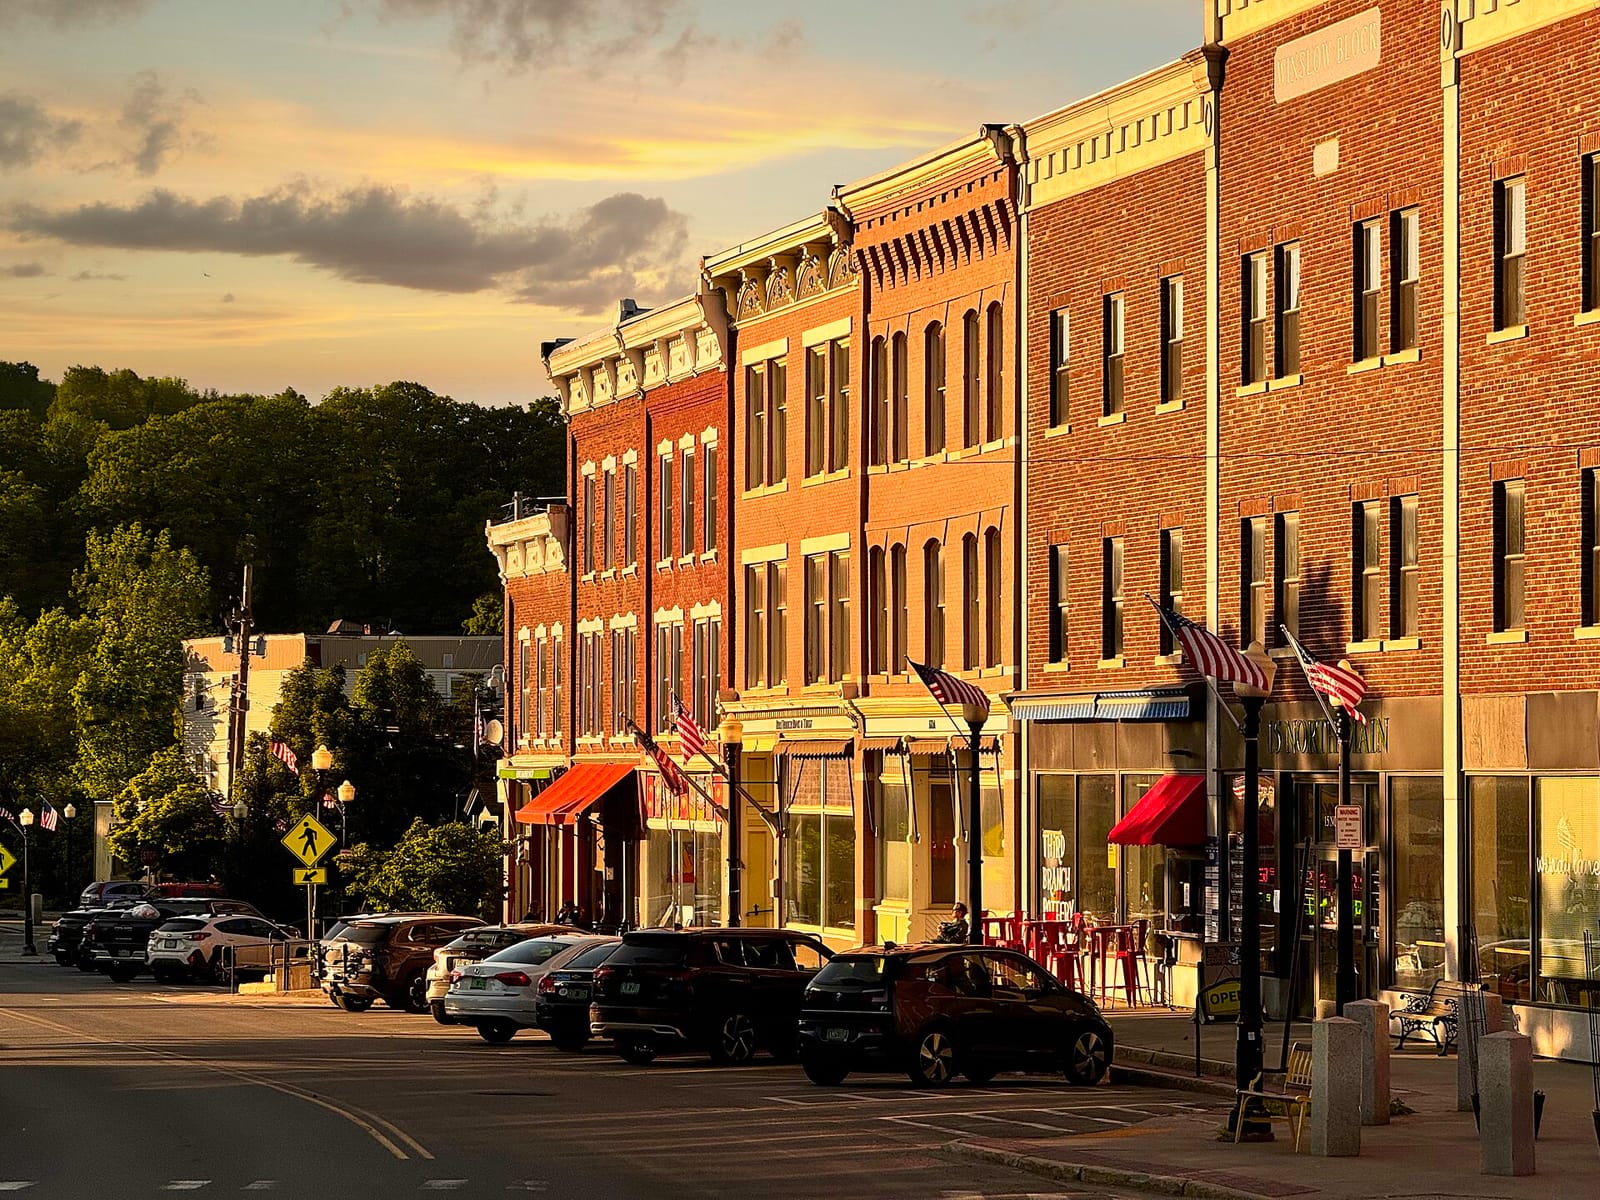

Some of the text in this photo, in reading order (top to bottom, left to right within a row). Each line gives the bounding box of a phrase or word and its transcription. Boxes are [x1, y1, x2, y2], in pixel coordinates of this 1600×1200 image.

[1277, 23, 1377, 84] WINSLOW BLOCK
[1285, 719, 1339, 754] NORTH
[1042, 866, 1071, 893] BRANCH
